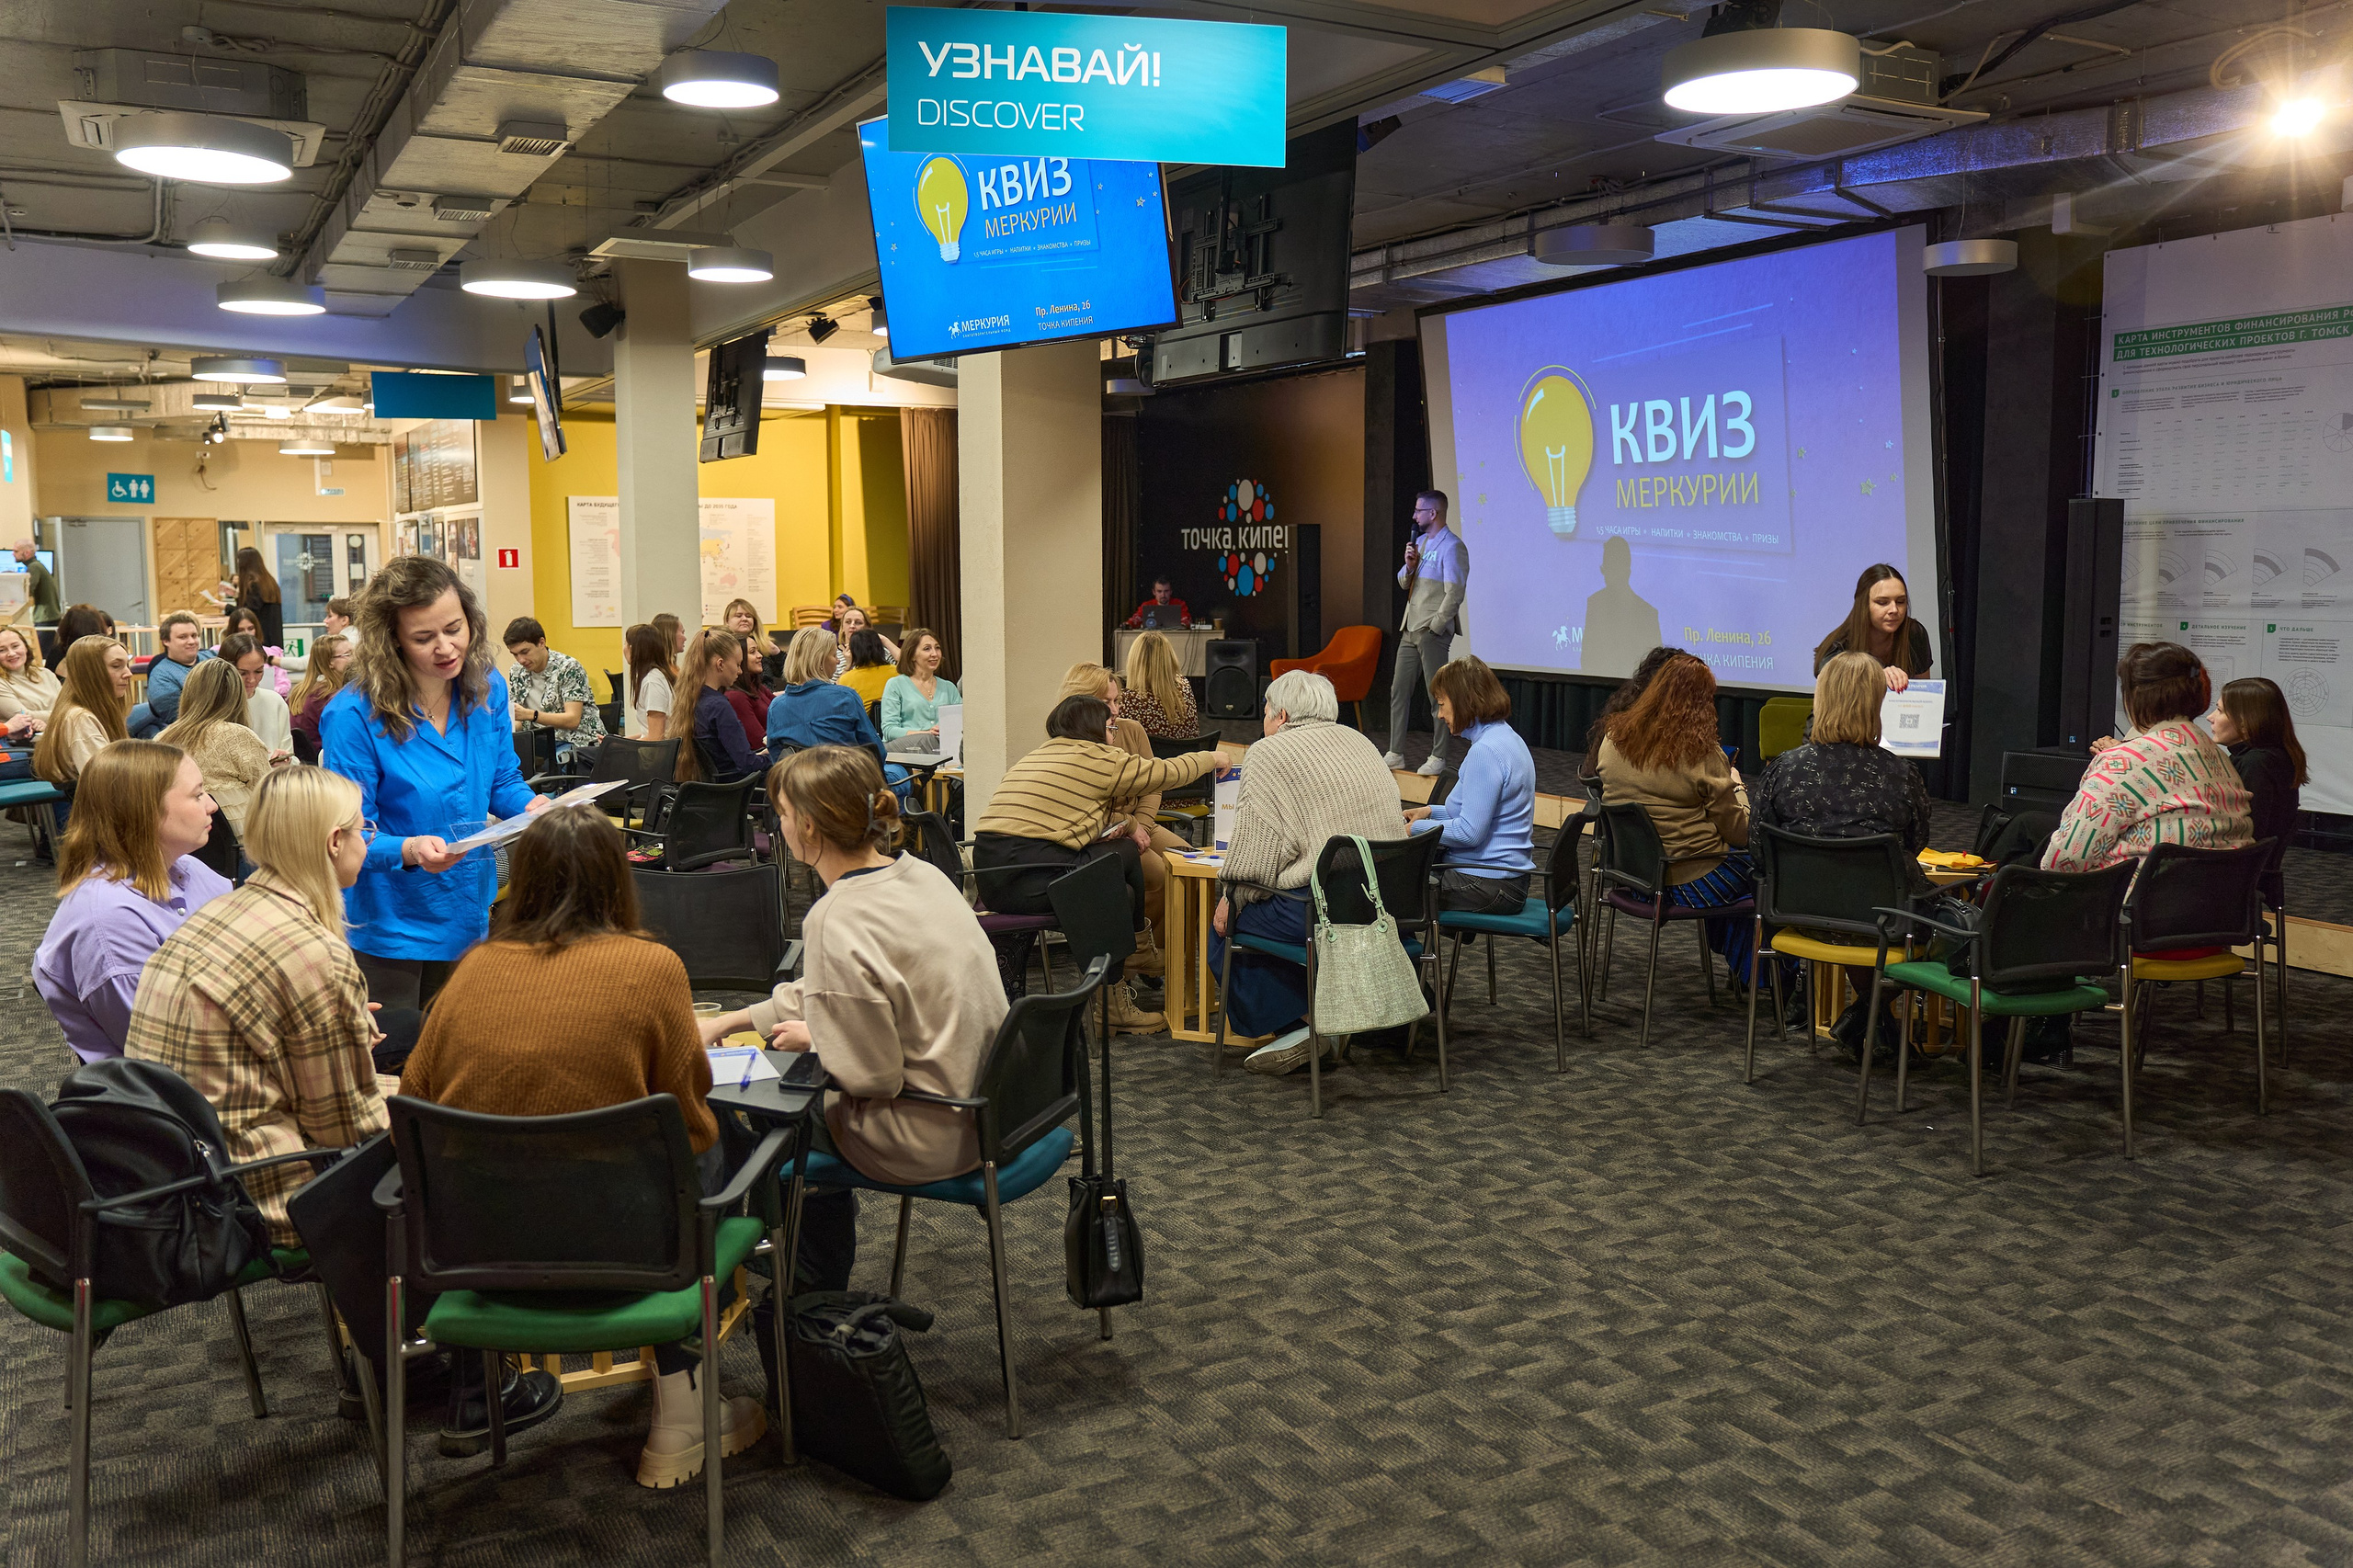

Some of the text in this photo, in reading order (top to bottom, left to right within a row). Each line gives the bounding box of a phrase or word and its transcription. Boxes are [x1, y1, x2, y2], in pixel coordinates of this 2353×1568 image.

[917, 40, 1161, 87] УЗНАВАЙ!
[917, 98, 1085, 131] DISCOVER
[978, 157, 1073, 210] КВИЗ
[984, 201, 1077, 239] МЕРКУРИИ
[1037, 241, 1069, 251] ЗНАКОМСТВА
[961, 314, 1010, 333] МЕРКУРИЯ
[1035, 300, 1091, 319] Пр. Ленина, 26
[1038, 315, 1094, 331] ТОЧКА КИПЕНИЯ
[2117, 324, 2350, 360] ДЛЯ ТЕХНОЛОГИЧЕСКИХ ПРОЕКТОВ Г. ТОМСК
[2118, 334, 2148, 345] КАРТА
[2152, 324, 2232, 341] ИНСТРУМЕНТОВ
[2234, 310, 2338, 331] ФИНАНСИРОВАНИЯ
[1610, 390, 1756, 465] КВИЗ
[1616, 472, 1760, 509] МЕРКУРИИ
[1605, 526, 1622, 534] ЧАСА
[1622, 527, 1641, 536] ИГРЫ
[1651, 528, 1684, 538] НАПИТКИ
[1693, 529, 1743, 542] ЗНАКОМСТВА
[1752, 533, 1779, 544] ПРИЗЫ
[1684, 627, 1771, 648] Пр. Ленина, 26
[1722, 653, 1774, 670] КИПЕНИЯ
